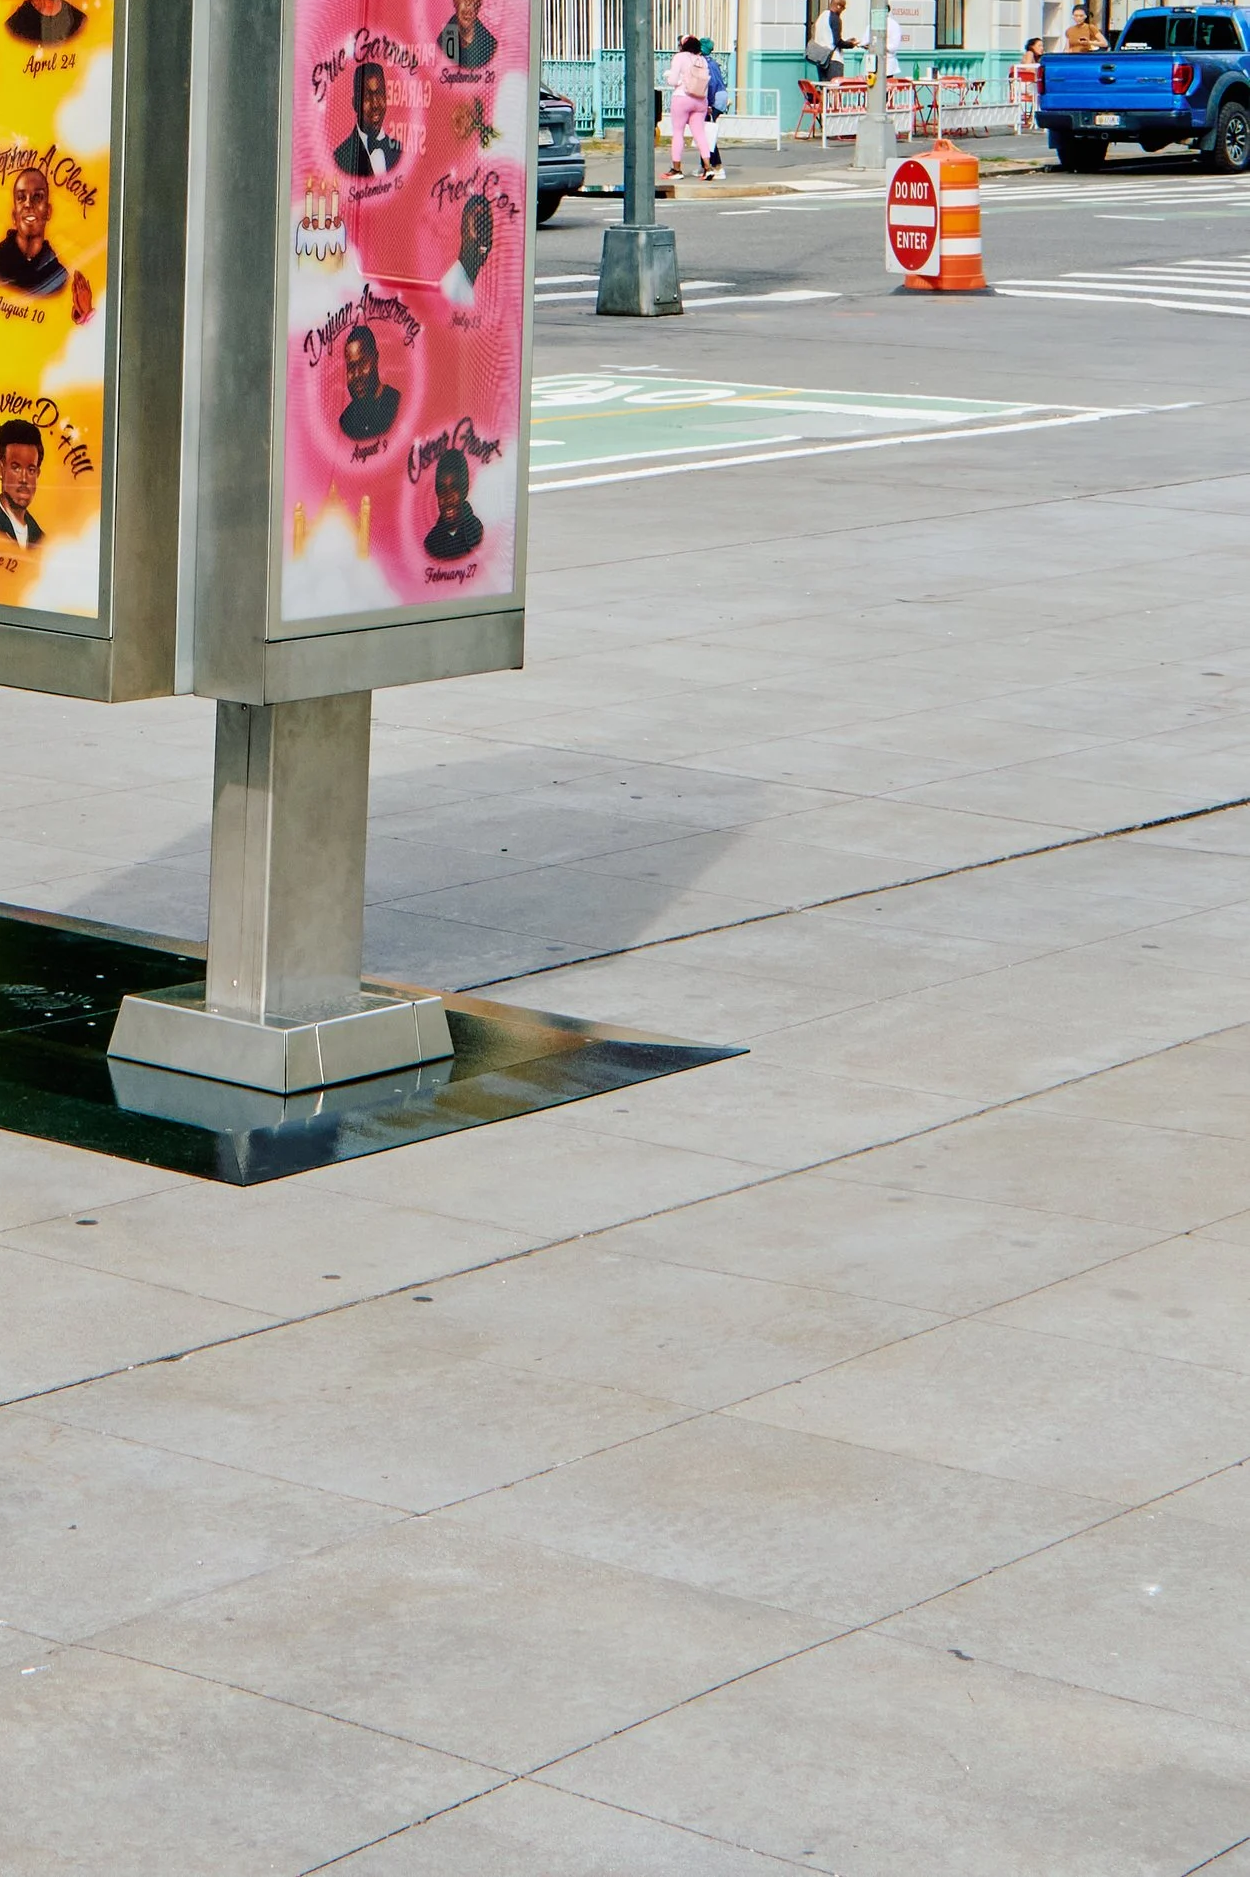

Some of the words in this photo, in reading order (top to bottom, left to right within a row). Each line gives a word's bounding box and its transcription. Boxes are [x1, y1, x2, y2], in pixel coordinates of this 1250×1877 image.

[23, 53, 58, 78] April
[60, 53, 76, 70] 24
[312, 48, 345, 103] Eric
[53, 156, 98, 219] Clark
[895, 181, 908, 199] DO
[910, 182, 929, 200] NOT
[896, 231, 927, 250] ENTER
[31, 311, 46, 324] 10
[353, 283, 420, 349] Armstrong
[5, 558, 18, 573] 12
[425, 567, 466, 585] February
